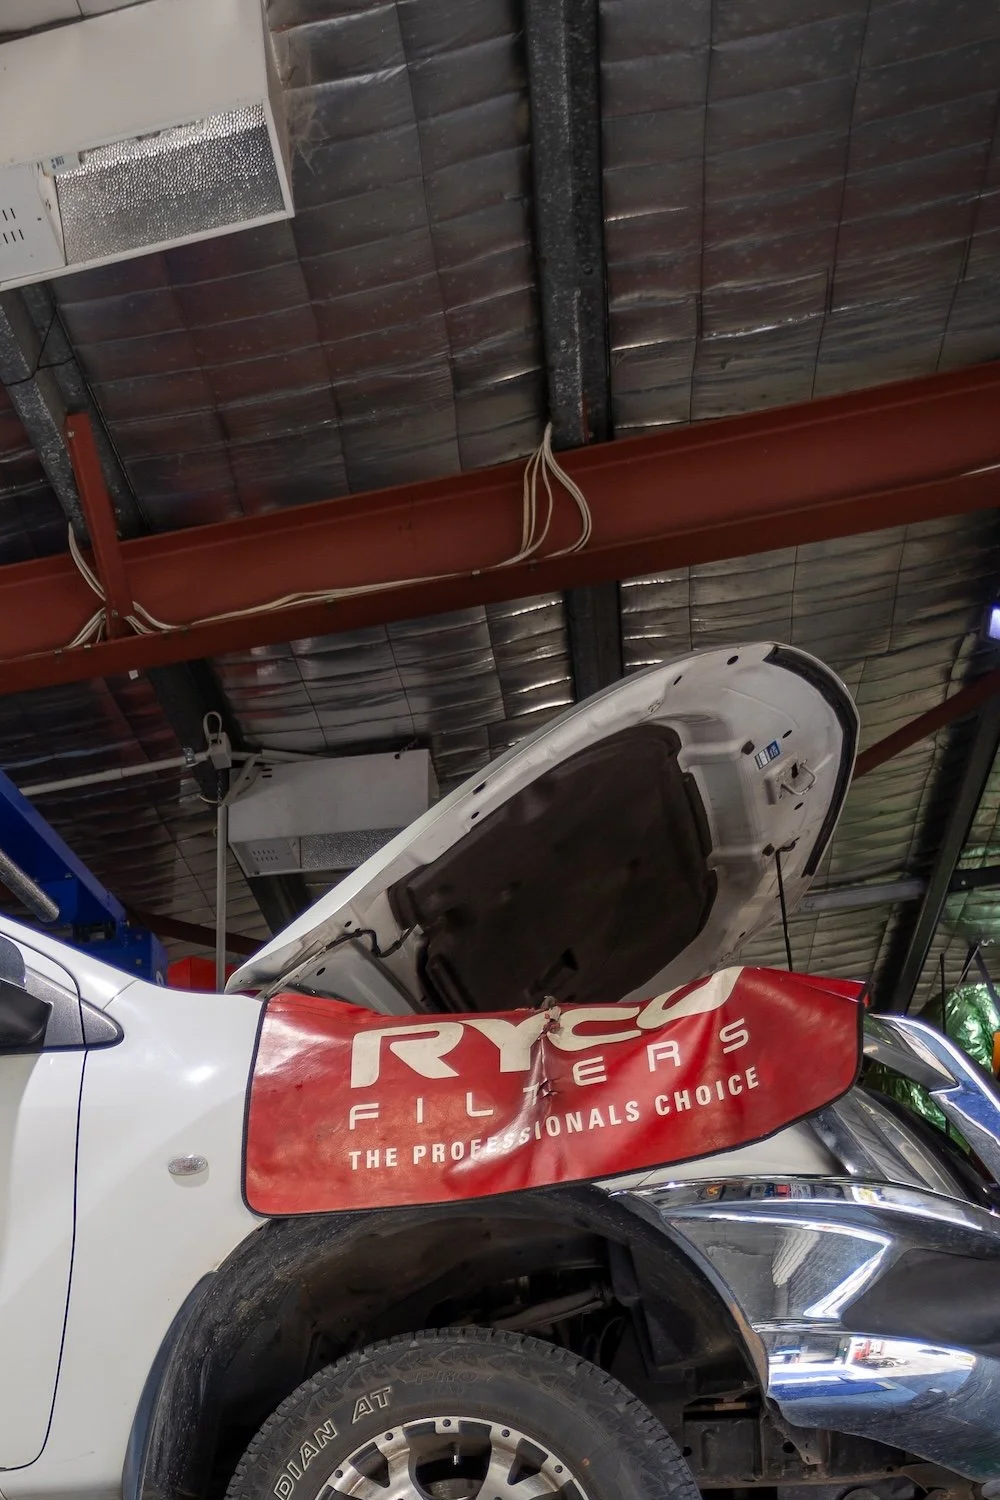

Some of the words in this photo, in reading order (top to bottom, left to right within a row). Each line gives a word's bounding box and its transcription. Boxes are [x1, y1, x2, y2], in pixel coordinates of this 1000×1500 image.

[350, 966, 745, 1089] RYCO
[349, 1147, 397, 1170] THE
[413, 1100, 640, 1164] PROFESSIONALS
[654, 1066, 759, 1116] CHOICE
[352, 1386, 392, 1424] AT
